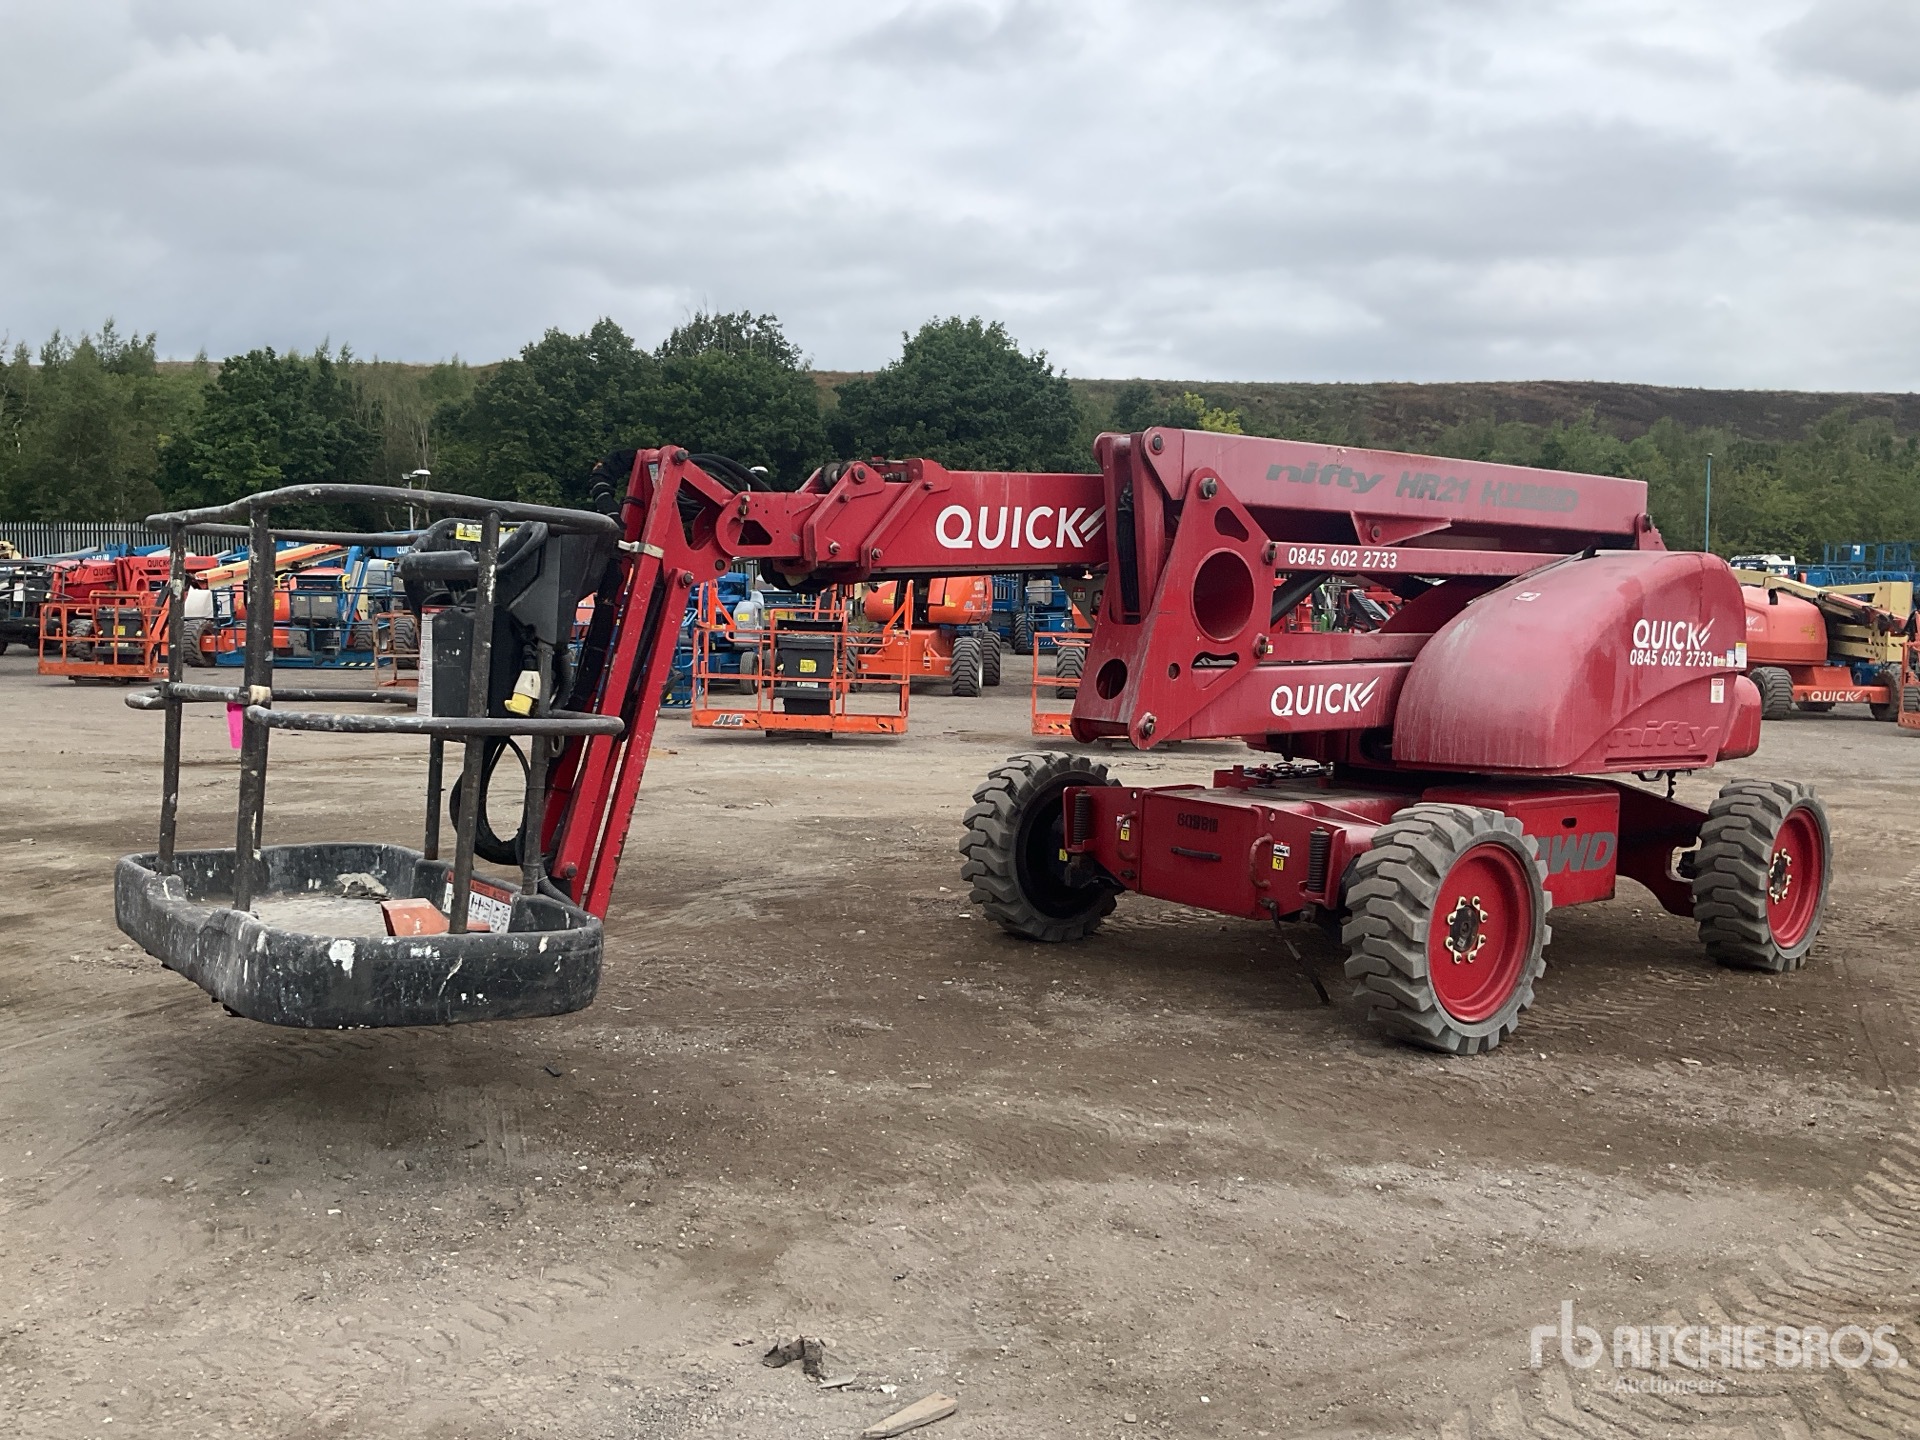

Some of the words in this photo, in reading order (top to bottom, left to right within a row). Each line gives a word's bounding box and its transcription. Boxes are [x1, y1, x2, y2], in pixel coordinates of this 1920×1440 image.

[1266, 461, 1385, 494] nifty
[1395, 471, 1471, 503] HR21
[935, 504, 1087, 549] QUICK
[1288, 547, 1326, 566] 0845
[1330, 549, 1358, 567] 602
[1362, 551, 1398, 569] 2733
[1633, 619, 1703, 650] QUICK
[1630, 649, 1658, 666] 0845
[1661, 650, 1682, 667] 602
[1685, 651, 1713, 667] 2733
[1271, 683, 1364, 716] QUICK
[1811, 690, 1856, 702] QUICK
[712, 713, 745, 727] JLG
[1606, 720, 1720, 752] nifty
